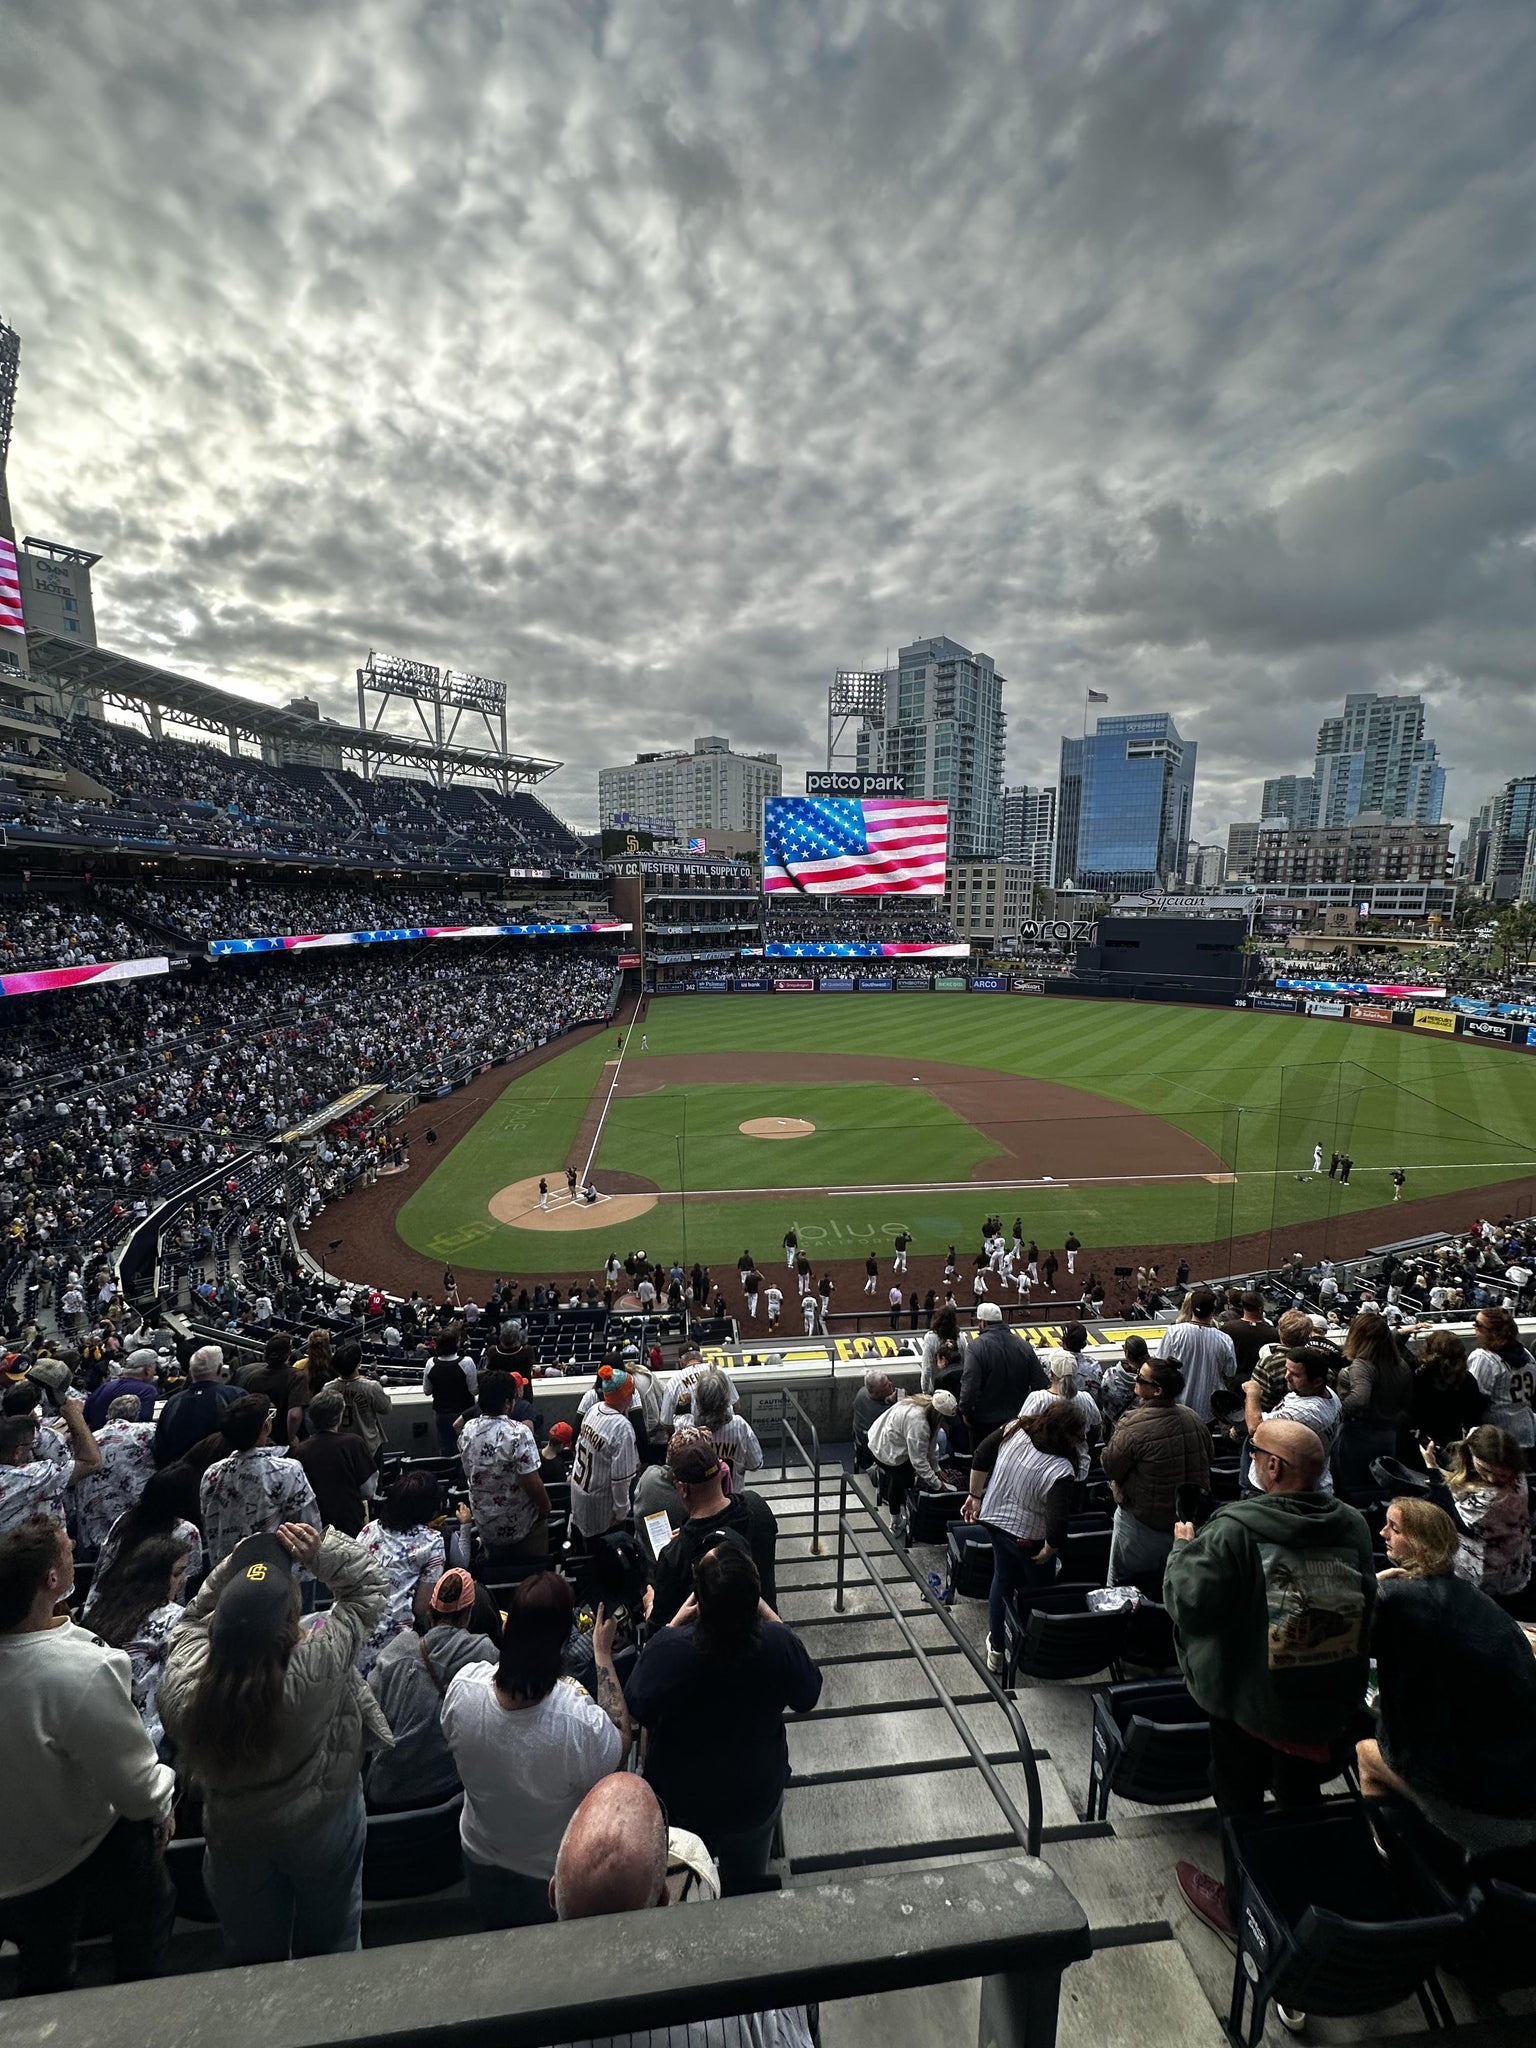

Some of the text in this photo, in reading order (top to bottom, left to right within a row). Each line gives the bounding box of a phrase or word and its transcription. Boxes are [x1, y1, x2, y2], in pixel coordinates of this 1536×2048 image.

[37, 561, 69, 577] OMNI
[35, 578, 74, 597] HOTEL
[808, 774, 905, 793] petco park
[641, 862, 680, 874] WESTERN
[683, 864, 709, 875] METAL
[711, 866, 738, 877] SUPPLY
[1138, 888, 1206, 912] Sycuan
[1013, 980, 1040, 991] Sycuan
[1235, 999, 1246, 1007] 396
[1469, 1022, 1507, 1034] EVOTEK
[793, 1220, 909, 1240] blue
[573, 1442, 593, 1494] 51
